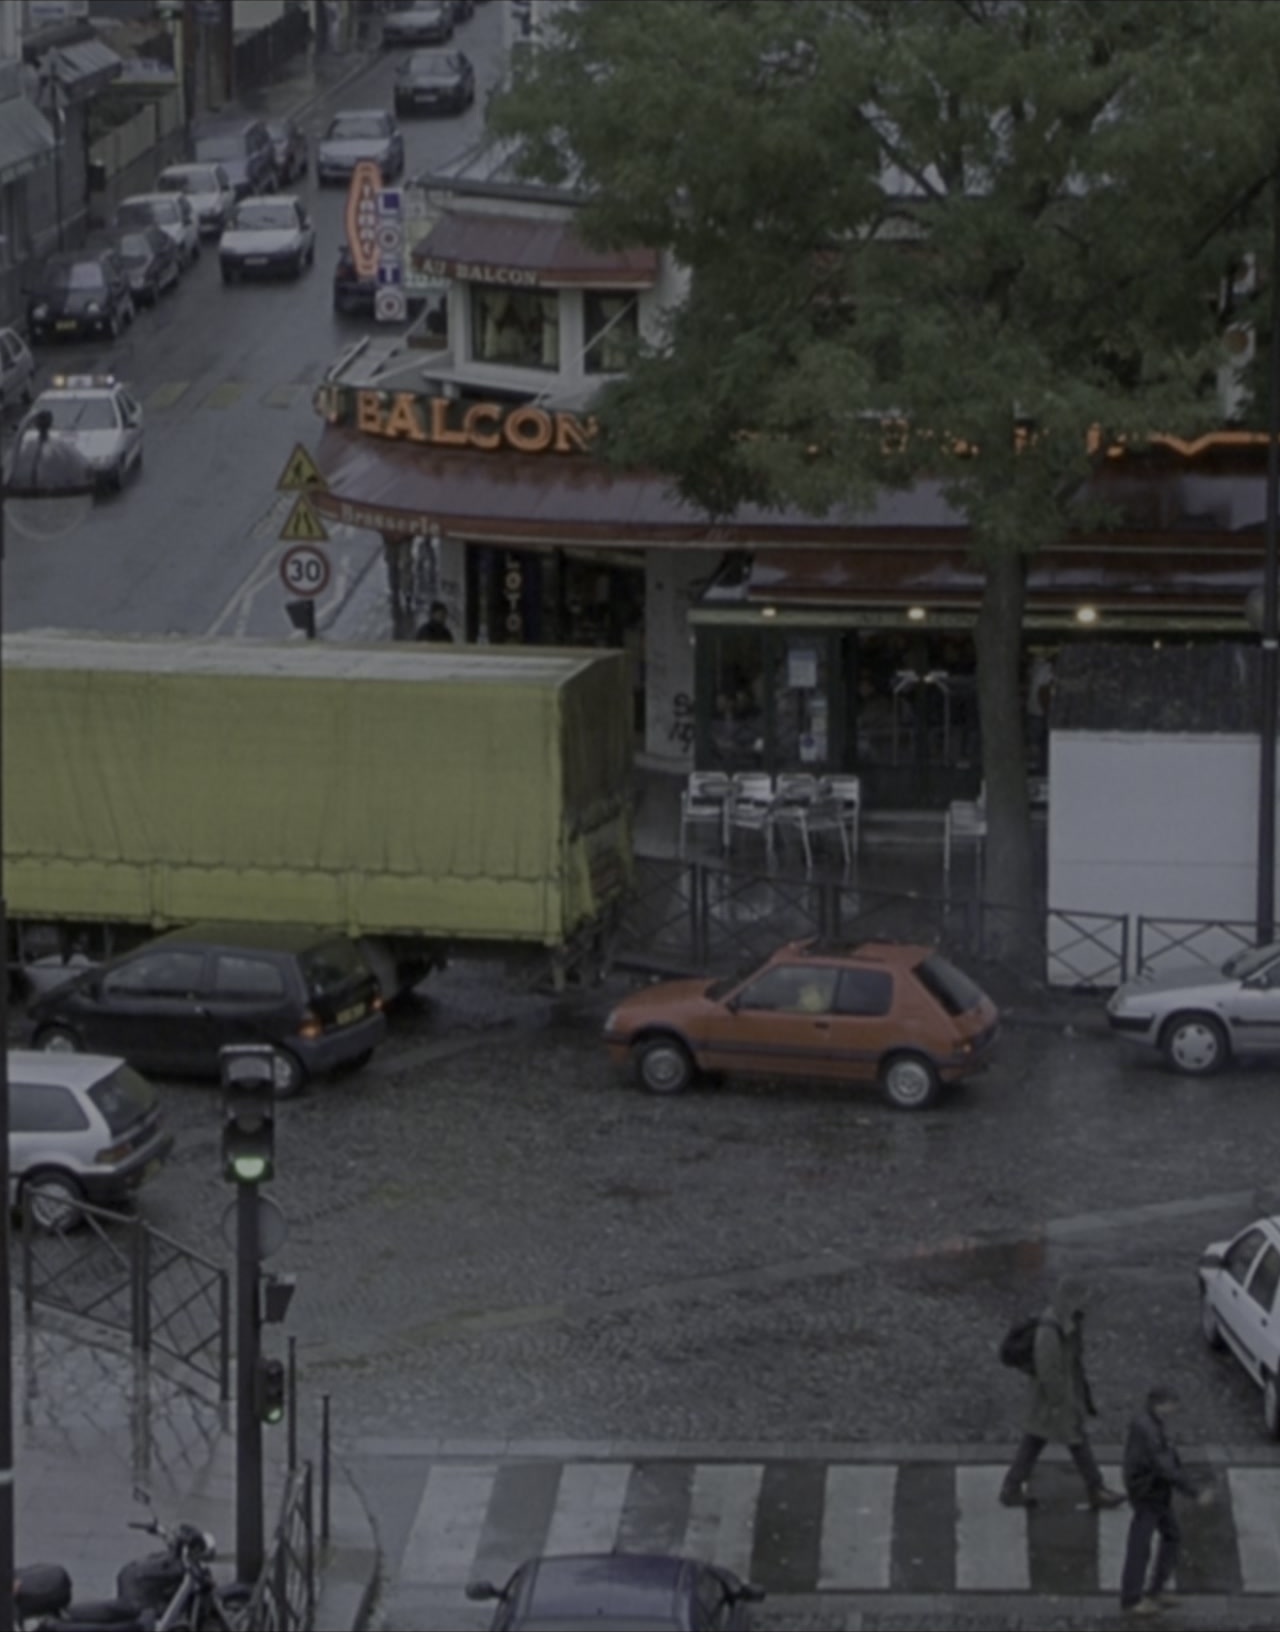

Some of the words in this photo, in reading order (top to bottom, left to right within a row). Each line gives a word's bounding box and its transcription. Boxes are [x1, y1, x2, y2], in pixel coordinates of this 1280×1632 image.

[375, 187, 407, 320] LOTO
[422, 258, 446, 276] AU
[456, 263, 540, 286] BALCON
[355, 387, 599, 451] BALCON
[340, 503, 441, 537] Brasserie
[289, 559, 321, 584] 30
